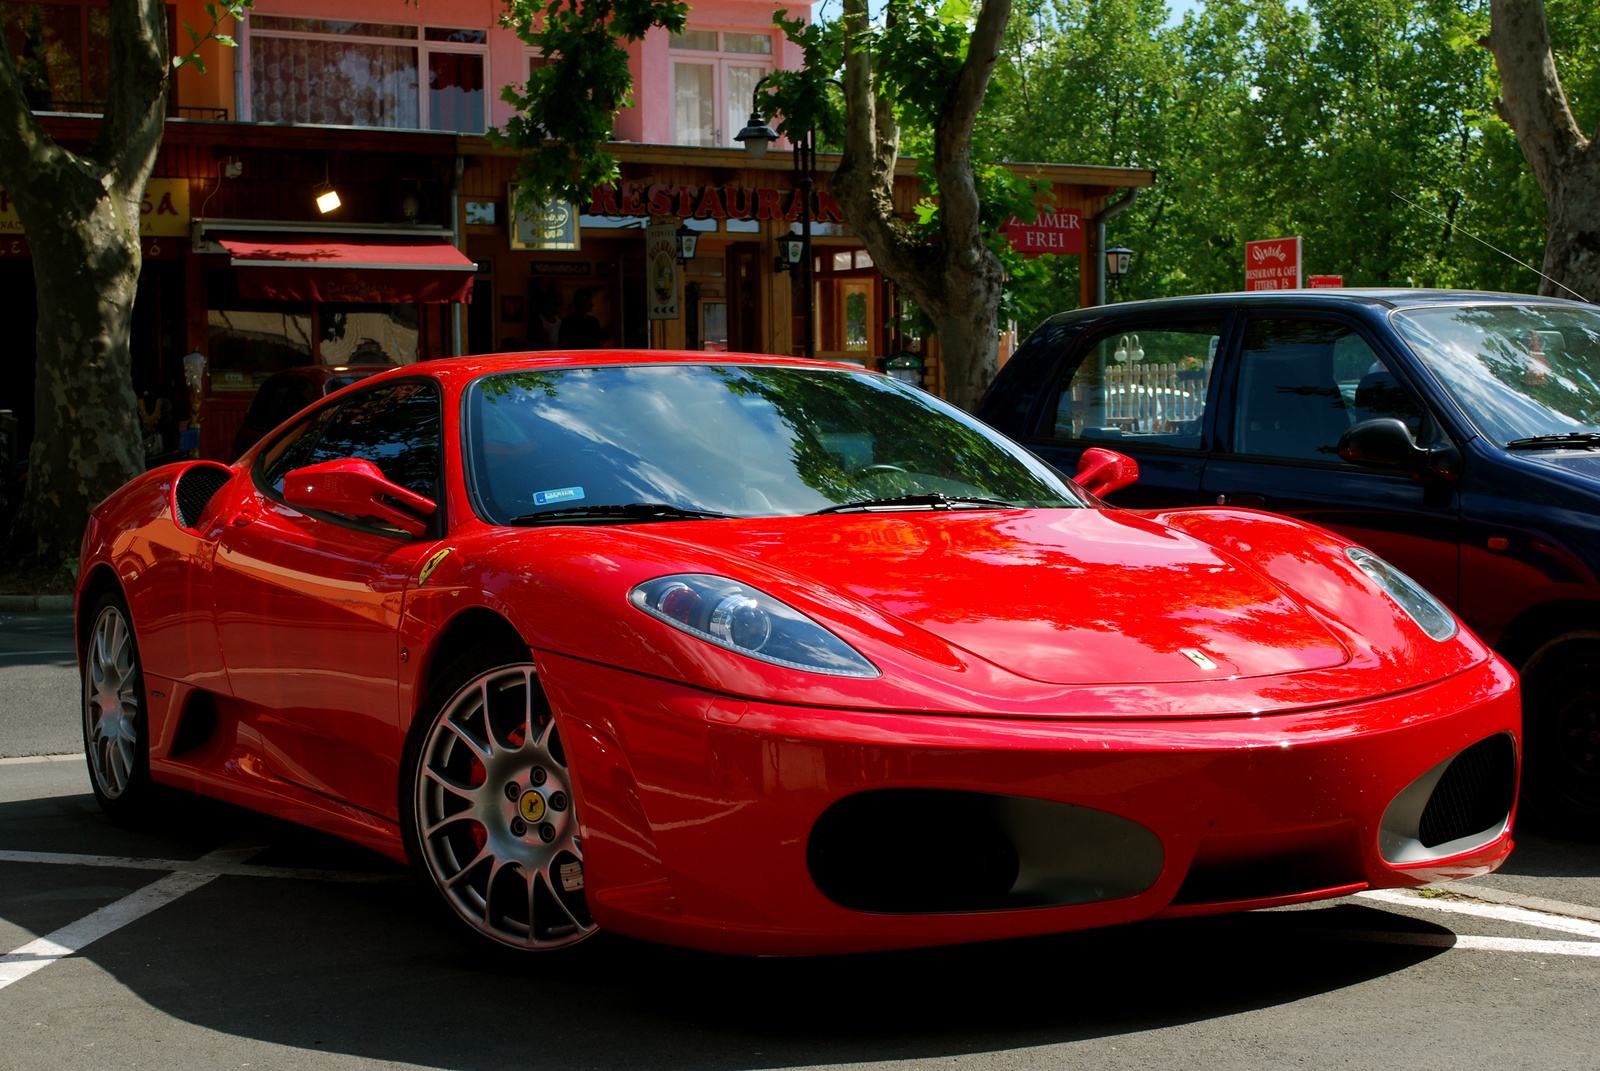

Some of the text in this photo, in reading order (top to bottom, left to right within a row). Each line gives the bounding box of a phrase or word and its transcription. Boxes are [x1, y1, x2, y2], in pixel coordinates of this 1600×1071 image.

[1009, 213, 1080, 229] ZMMER
[1026, 231, 1064, 248] FREI
[1246, 268, 1276, 279] RESTAURANT
[1277, 267, 1283, 277] &
